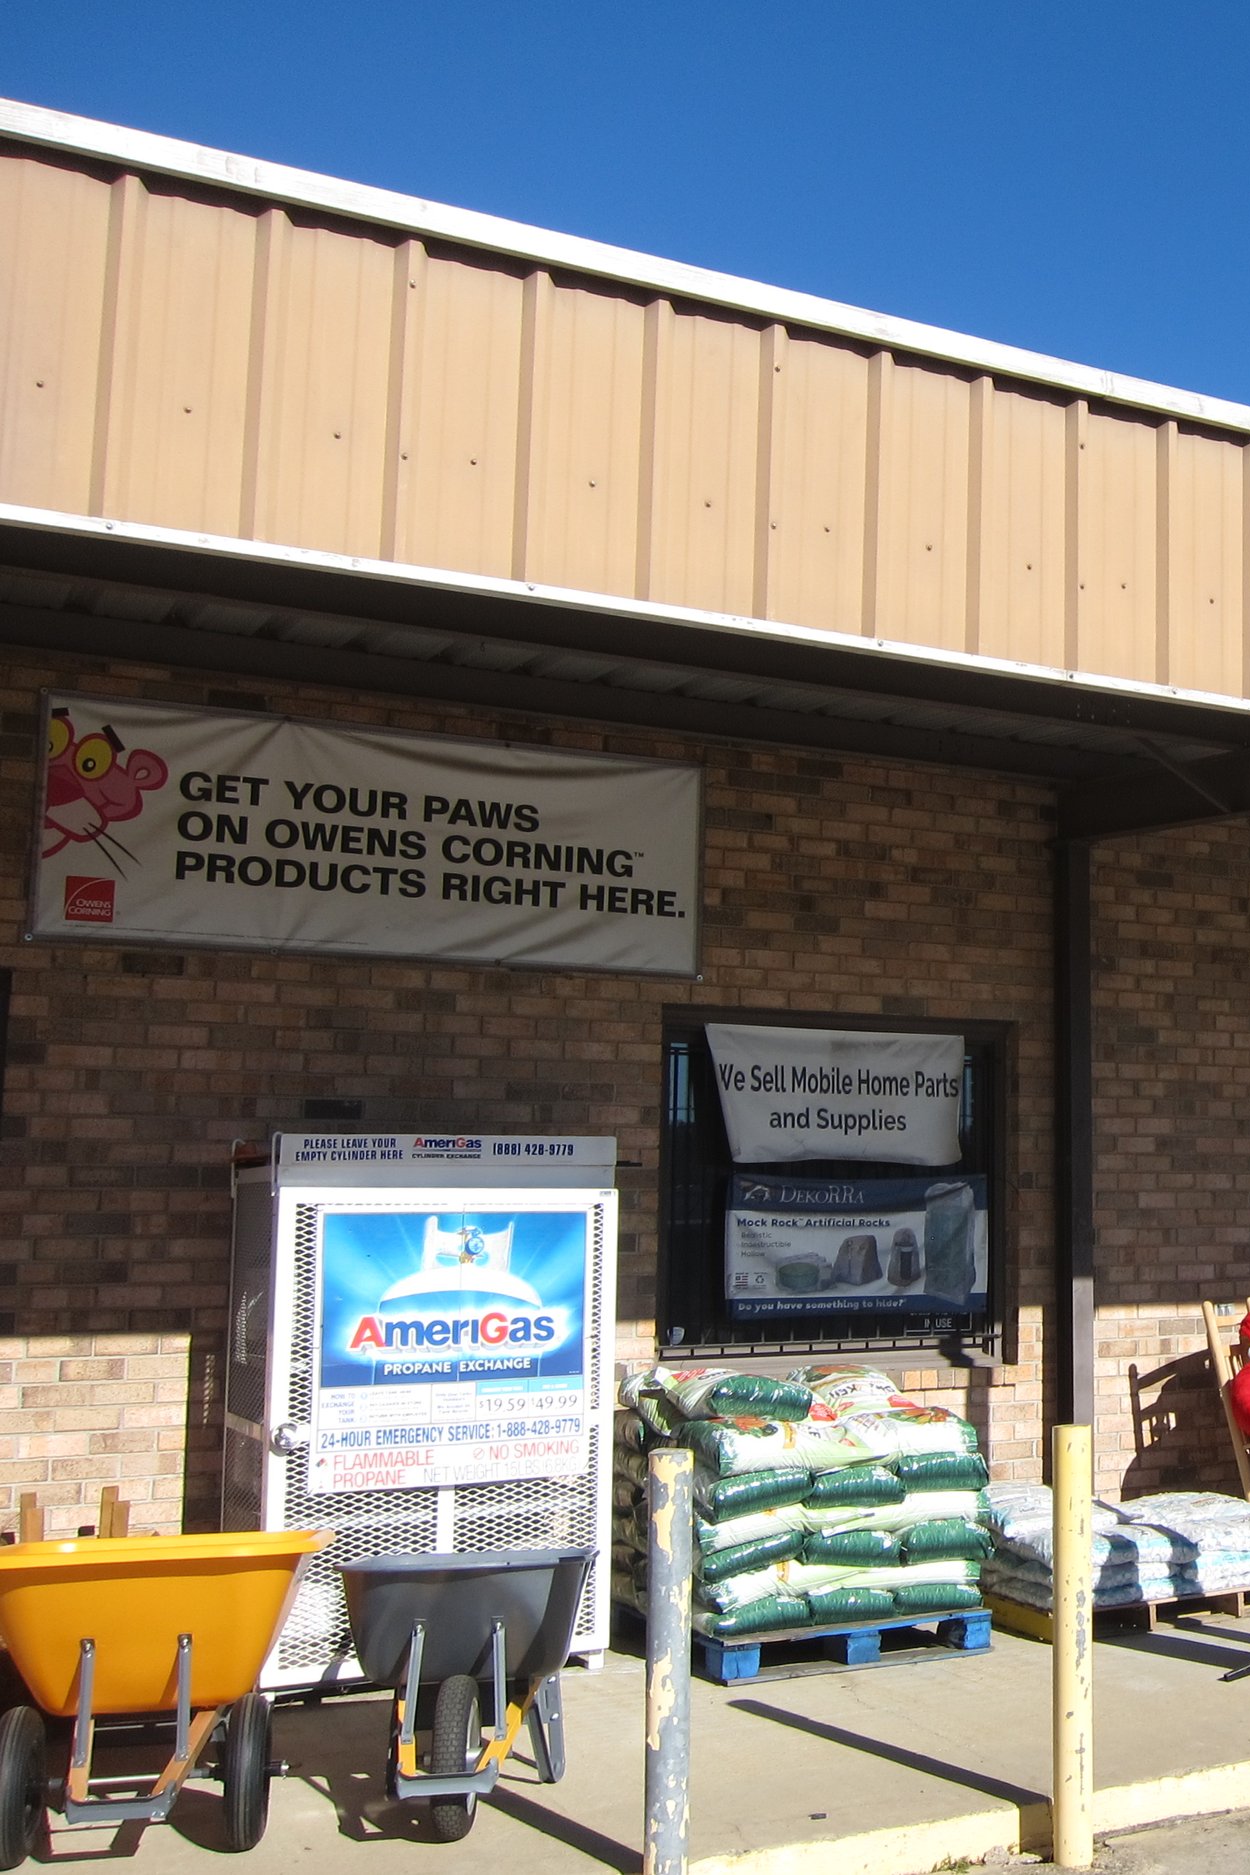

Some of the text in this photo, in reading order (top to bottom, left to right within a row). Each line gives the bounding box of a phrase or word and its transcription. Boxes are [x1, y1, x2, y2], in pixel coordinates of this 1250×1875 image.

[179, 771, 540, 832] GET YOUR PAWS
[177, 811, 247, 844] ON
[264, 818, 426, 859] OWENS
[175, 851, 685, 918] PRODUCTS RIGHT HERE.
[68, 906, 111, 917] CORNING
[76, 898, 112, 909] OWENS
[719, 1063, 959, 1098] We Sell Mobile Home Parts
[769, 1107, 907, 1136] and Supplies
[303, 1138, 396, 1149] PLEASE LEAVE YOUR
[413, 1137, 482, 1149] AmeriGas
[493, 1143, 574, 1156] (888) 428-9779
[295, 1149, 404, 1162] EMPTY CYLINDER HERE
[737, 1218, 767, 1228] Mock
[804, 1218, 856, 1228] Artificial
[859, 1218, 890, 1228] Rocks
[738, 1303, 752, 1311] Do
[755, 1303, 774, 1312] you
[777, 1302, 803, 1310] have
[805, 1300, 859, 1311] something
[862, 1300, 873, 1309] to
[350, 1312, 554, 1348] AmeriGas
[935, 1318, 952, 1328] USE
[384, 1357, 531, 1375] PROPANE EXCHANGE
[321, 1418, 580, 1449] 24-HOUR EMERGENCY SERVICE: 1-888-428-9779
[489, 1440, 579, 1460] NO SMOKING
[333, 1450, 434, 1471] FLAMMABLE
[333, 1470, 406, 1489] PROPANE
[424, 1467, 450, 1483] NET
[454, 1463, 500, 1481] WEIGHT
